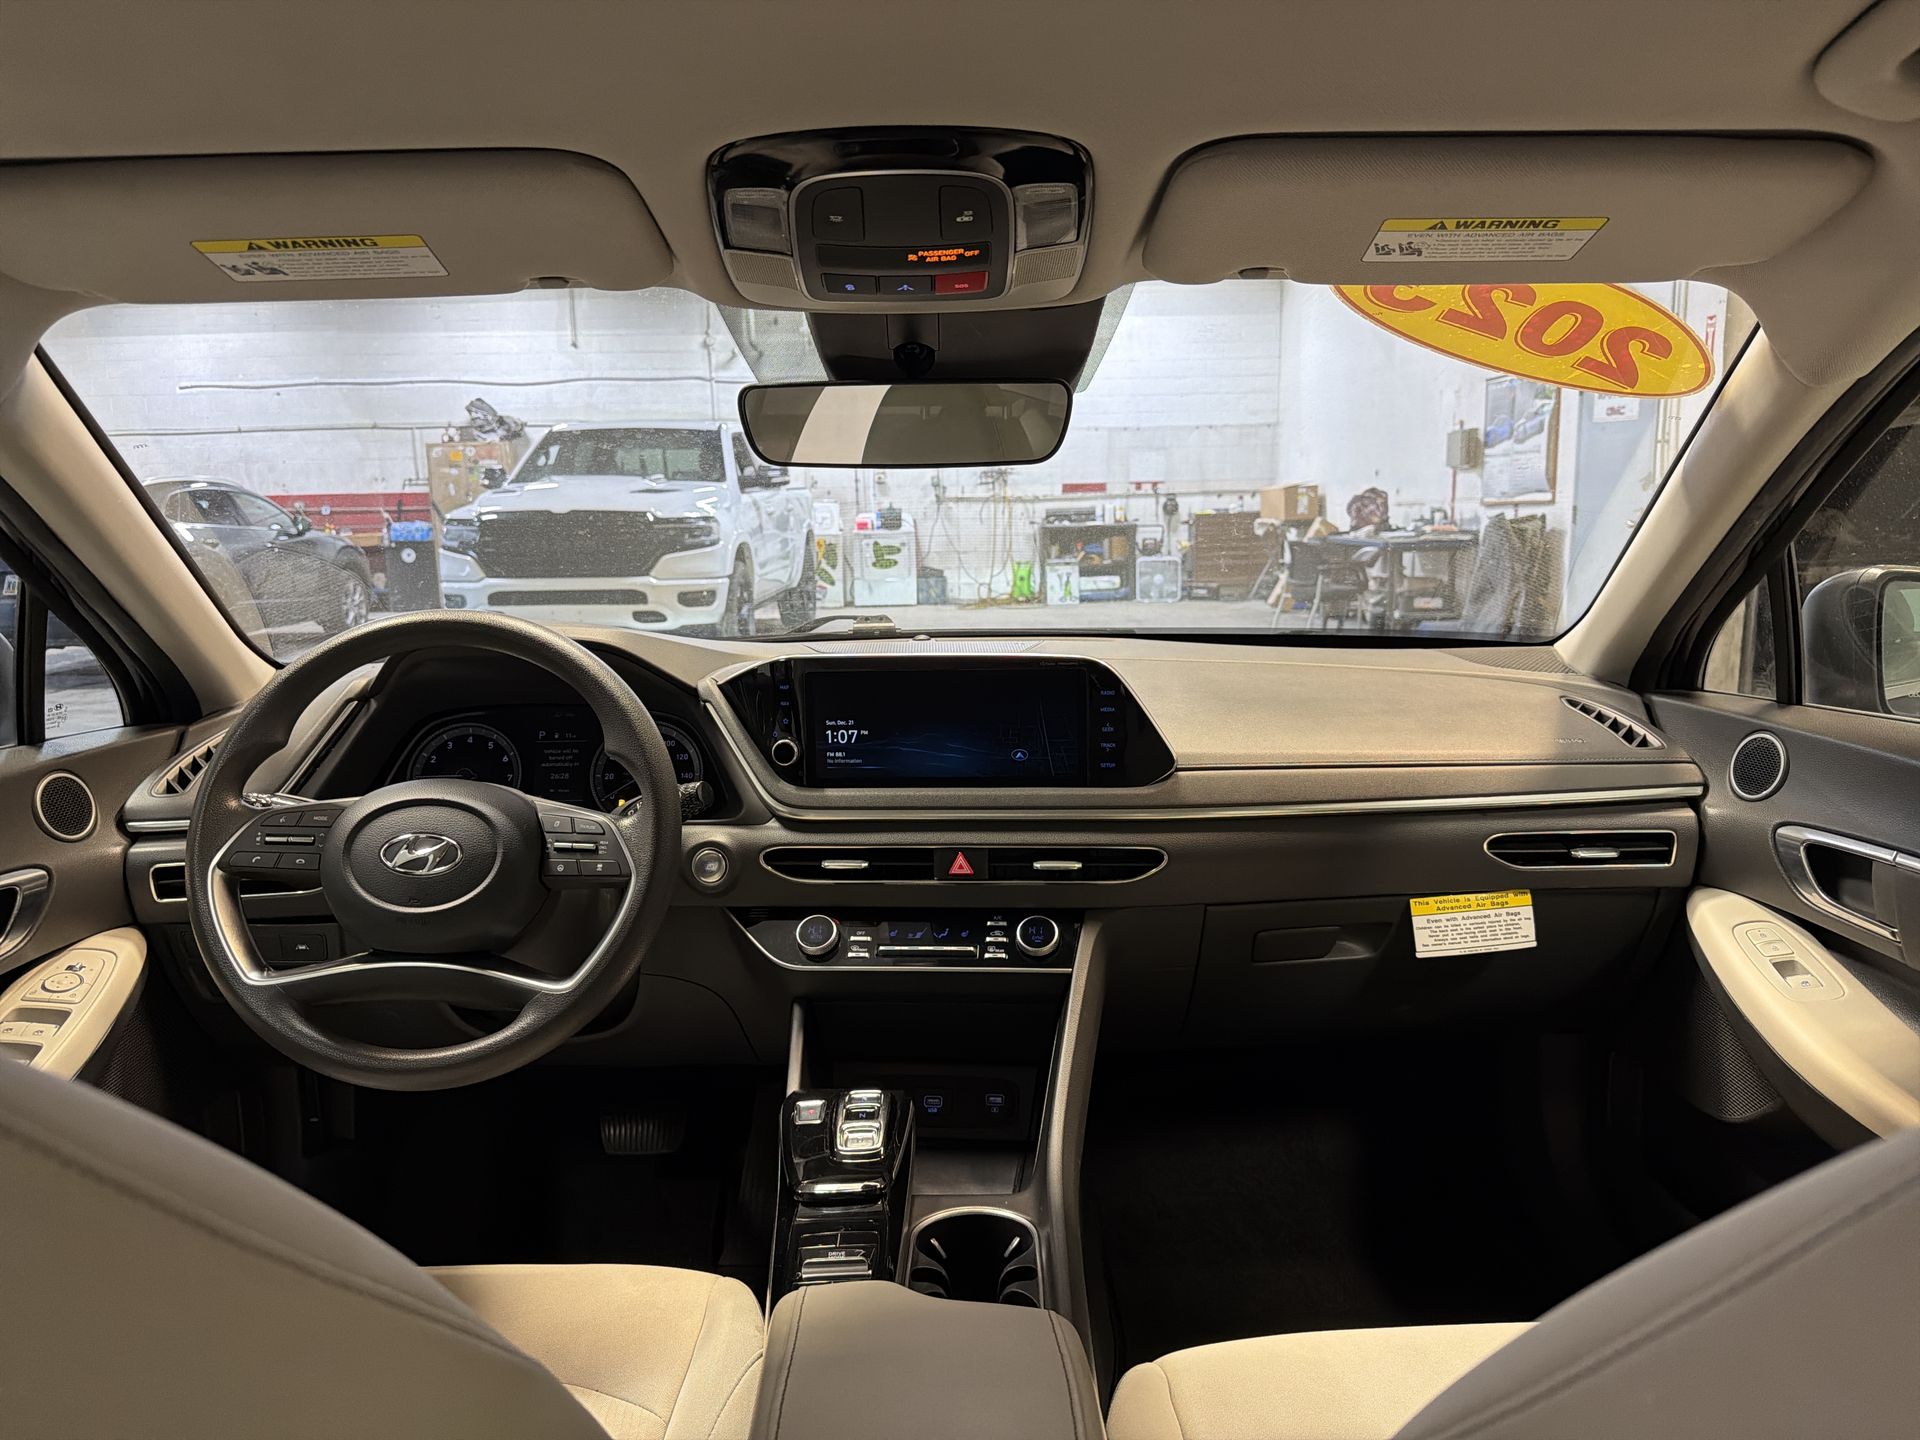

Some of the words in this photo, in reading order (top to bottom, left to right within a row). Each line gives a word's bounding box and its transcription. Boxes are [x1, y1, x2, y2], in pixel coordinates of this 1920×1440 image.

[1454, 219, 1560, 230] WARNING
[267, 238, 379, 250] WARNING
[918, 248, 964, 257] PASSENGER
[538, 730, 546, 740] P
[826, 730, 858, 744] 1:07
[488, 742, 494, 750] 5
[430, 755, 437, 764] 2
[502, 754, 509, 763] 6
[1475, 893, 1509, 902] Equipped
[1436, 904, 1472, 912] Advanced
